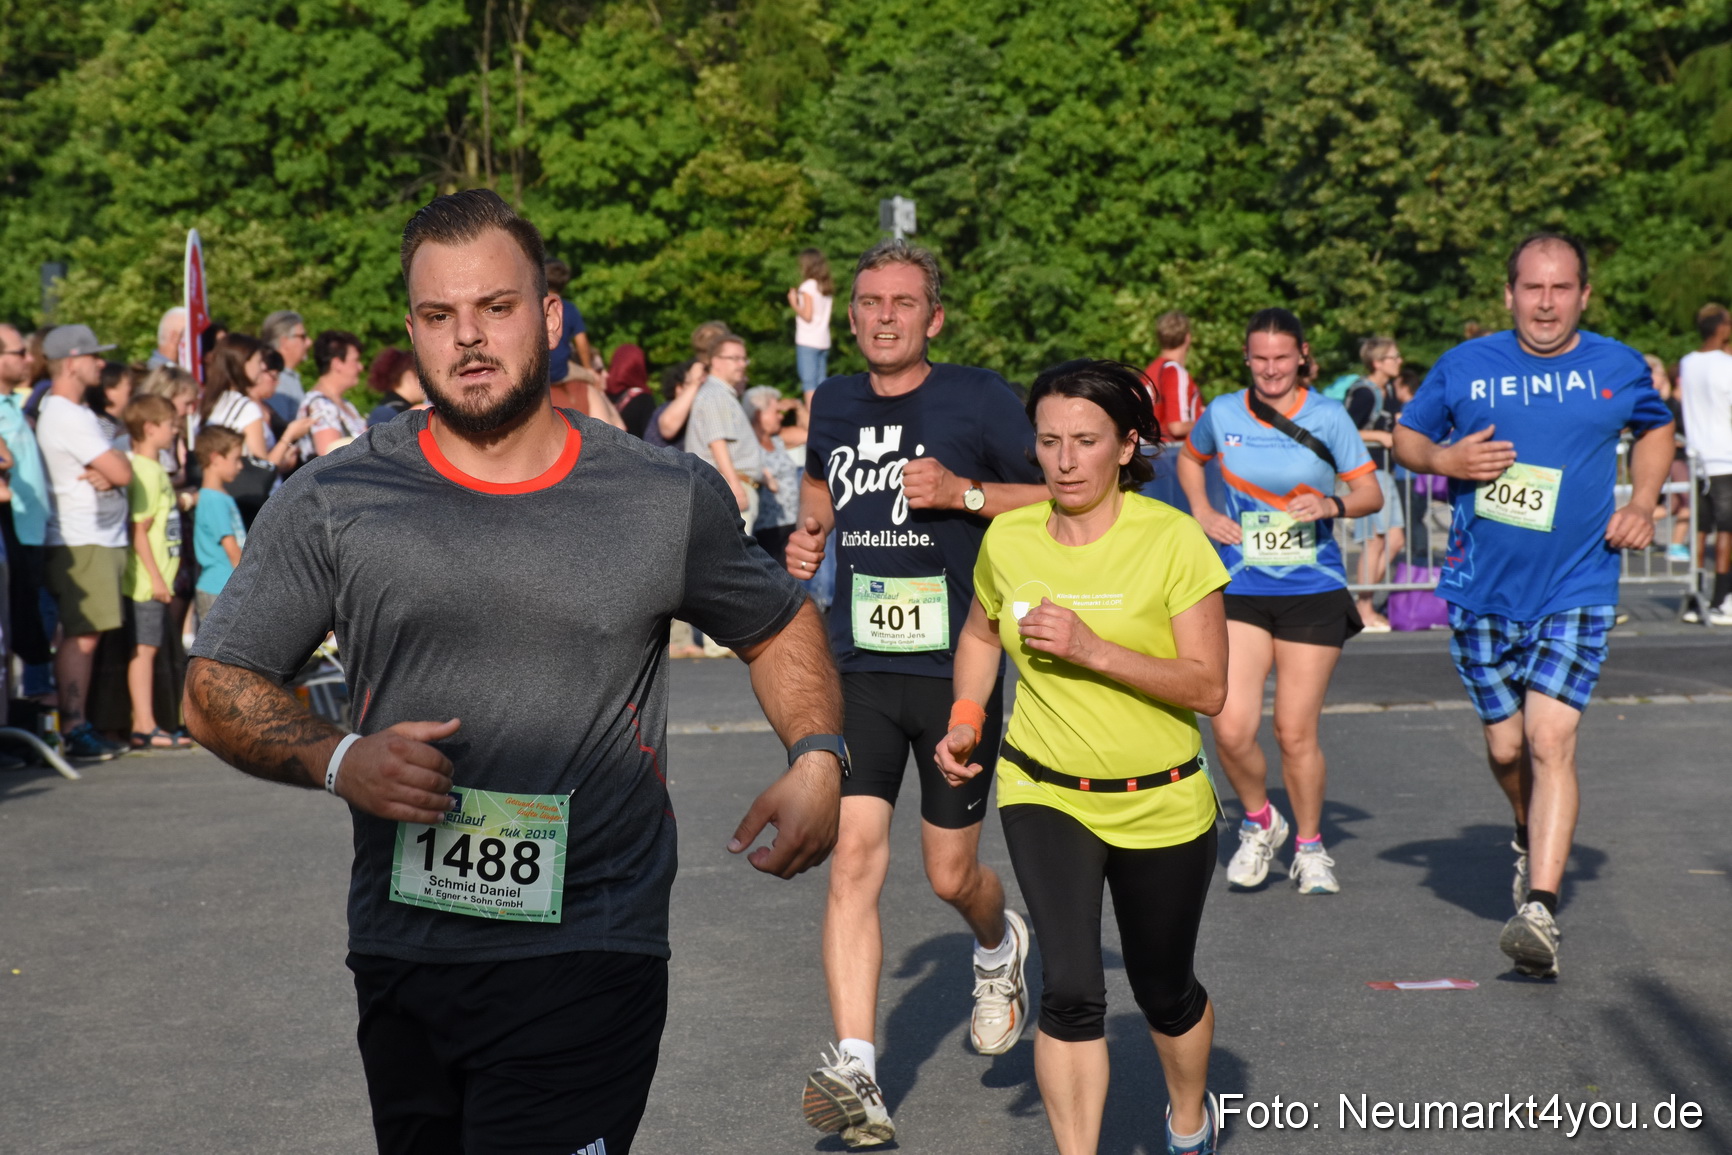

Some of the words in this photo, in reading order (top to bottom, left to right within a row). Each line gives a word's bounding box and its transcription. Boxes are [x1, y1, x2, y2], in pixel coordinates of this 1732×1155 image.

[1484, 481, 1544, 511] 2043
[841, 529, 935, 547] Knödelliebe.
[1252, 530, 1304, 550] 1921
[869, 604, 921, 631] 401
[870, 630, 905, 639] Wittmann
[907, 631, 926, 639] Jens
[524, 829, 557, 840] 2019
[416, 827, 541, 886] 1488
[429, 875, 476, 893] Schmid
[479, 883, 521, 898] Daniel
[423, 887, 434, 896] M.
[436, 889, 461, 902] Egner
[470, 894, 493, 905] Sohn
[495, 898, 524, 909] GmbH
